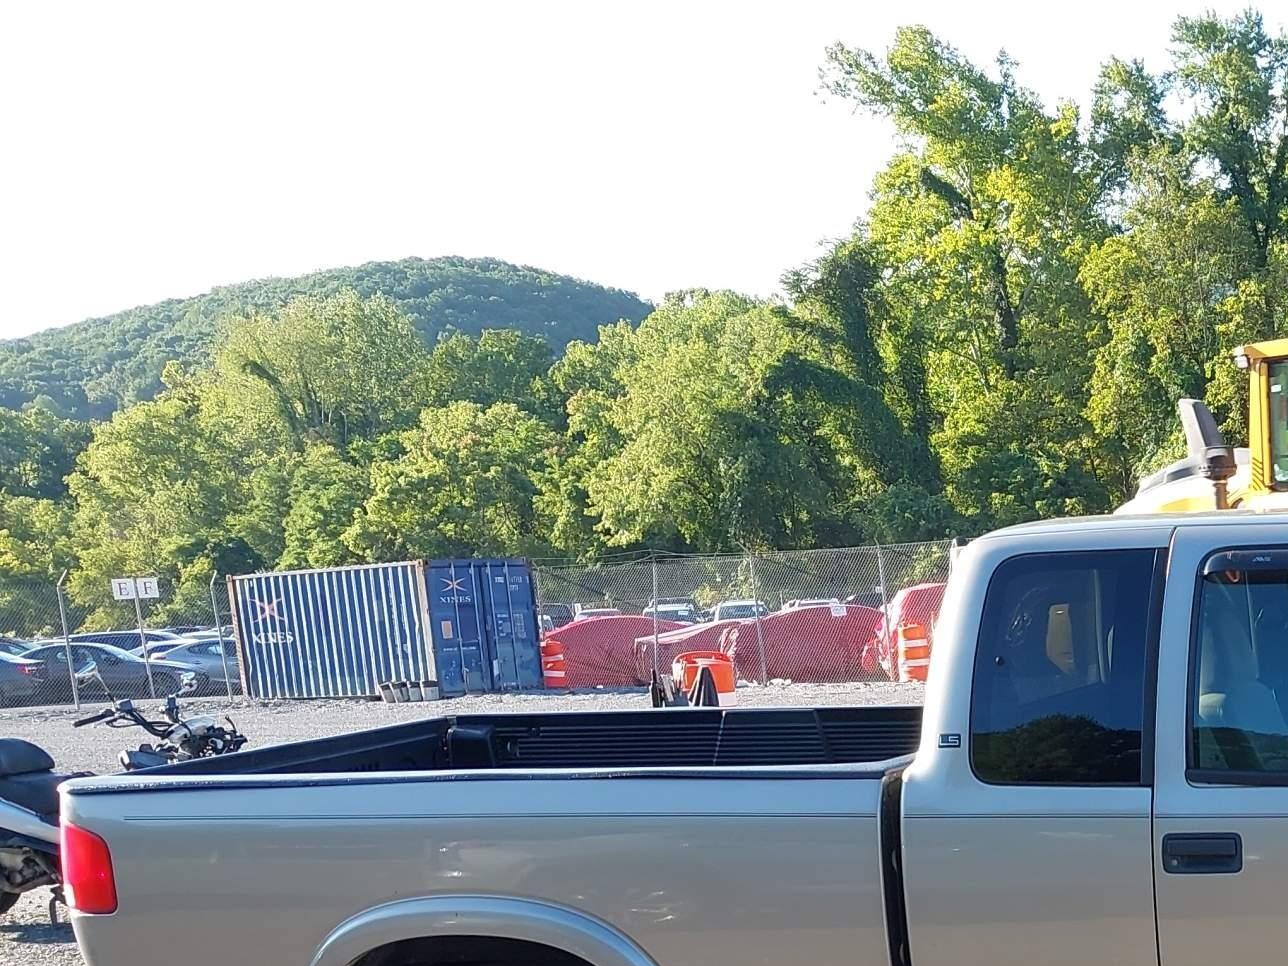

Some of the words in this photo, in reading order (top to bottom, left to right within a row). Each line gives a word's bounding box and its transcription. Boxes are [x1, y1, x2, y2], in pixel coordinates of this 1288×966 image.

[117, 582, 129, 596] E
[143, 581, 153, 595] F
[440, 595, 471, 603] XINES
[939, 735, 959, 746] LS
